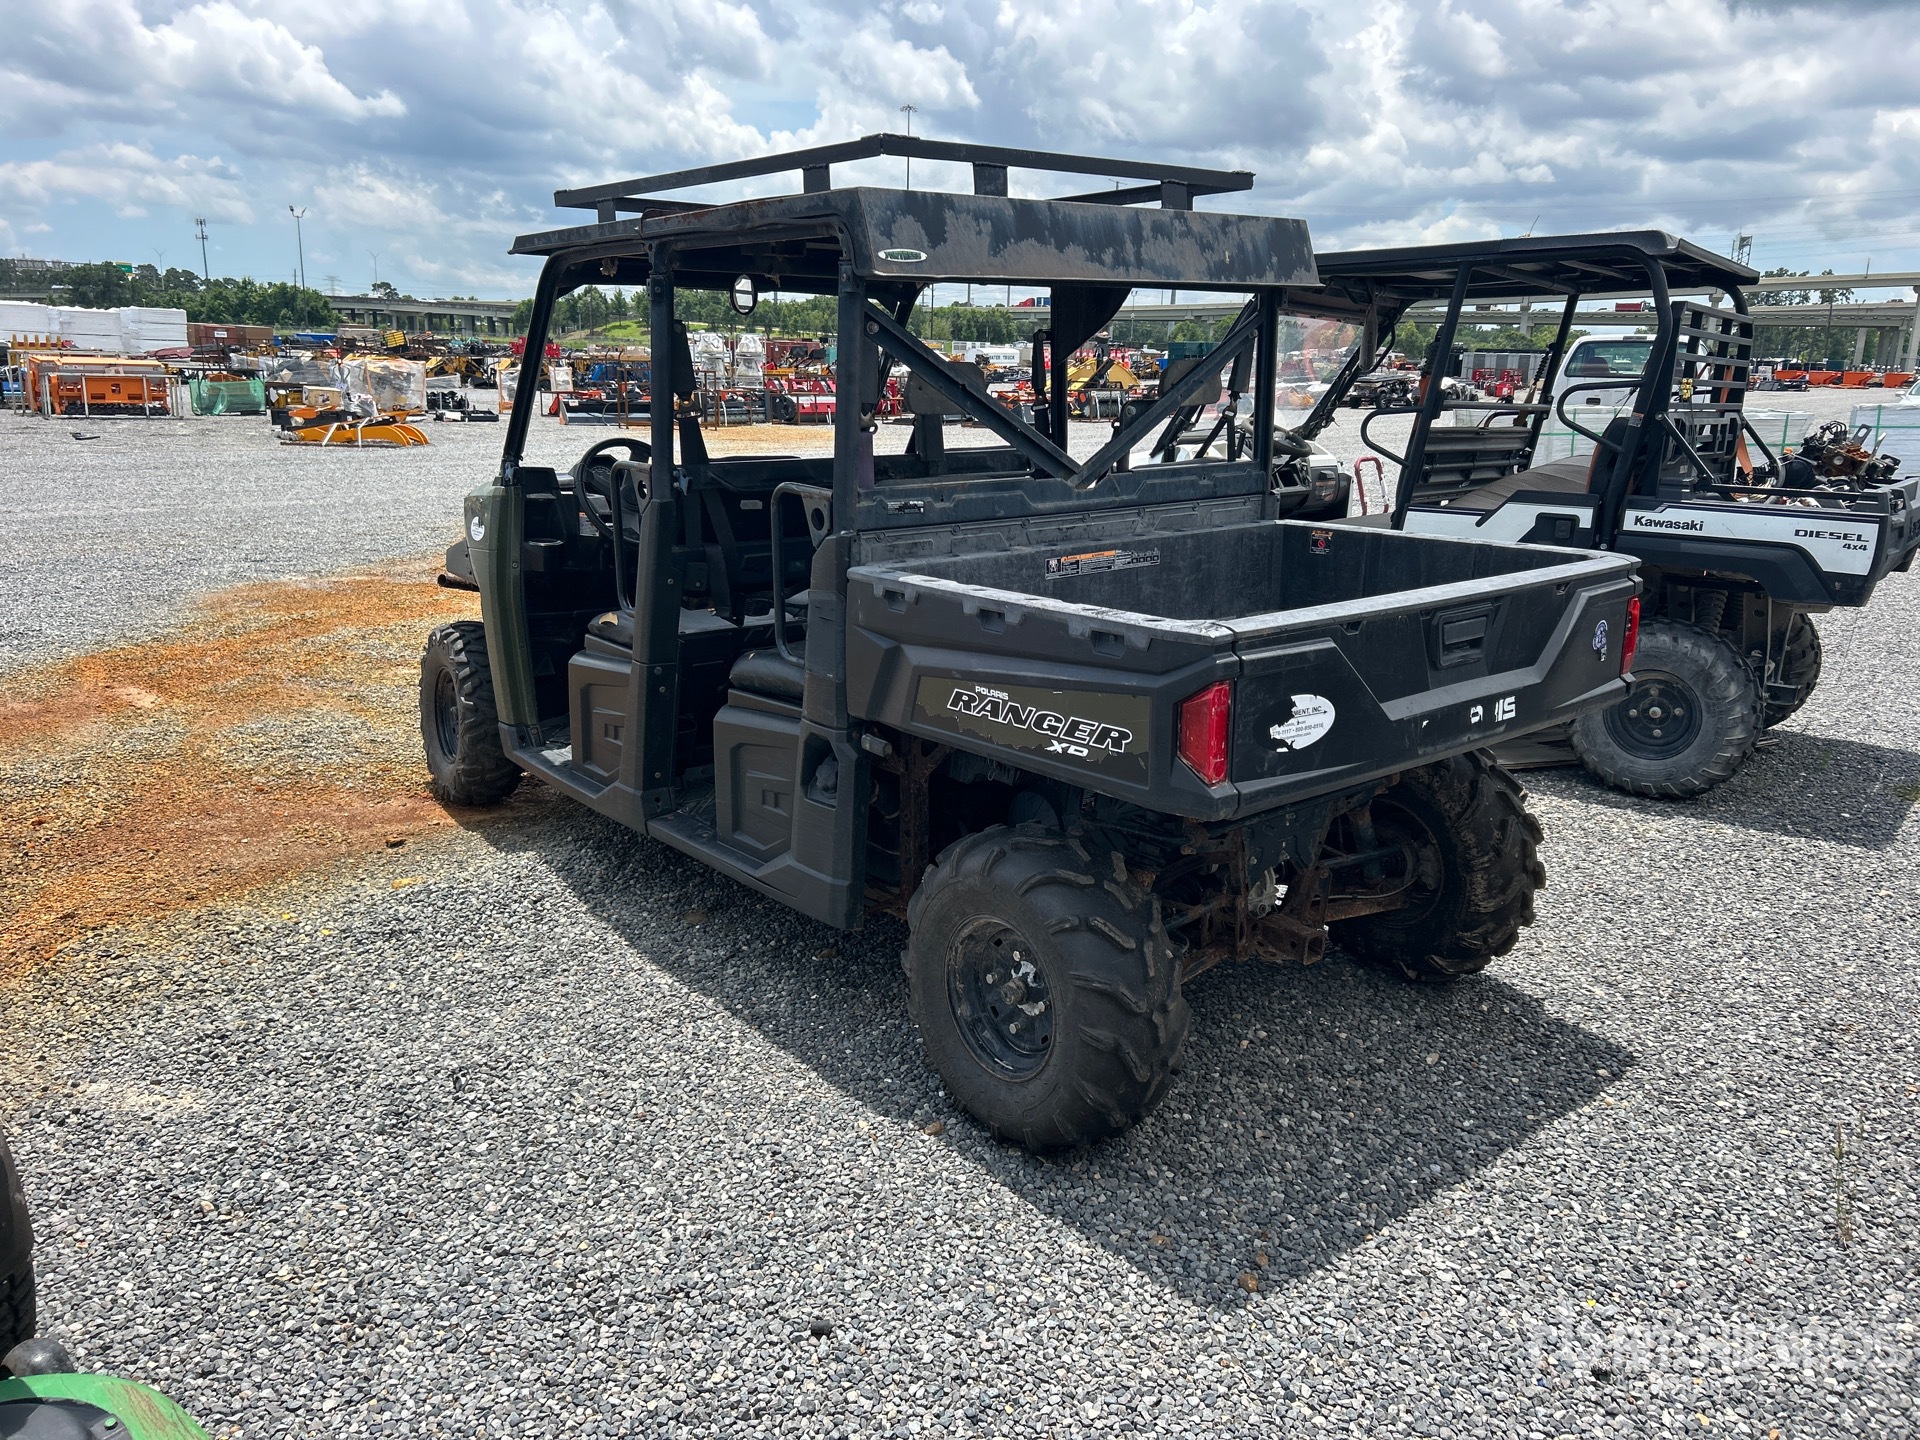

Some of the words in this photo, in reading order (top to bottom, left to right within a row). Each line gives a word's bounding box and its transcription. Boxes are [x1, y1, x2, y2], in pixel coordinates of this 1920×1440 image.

[1633, 515, 1704, 532] Kawasaki
[1794, 528, 1870, 543] DIESEL
[1842, 542, 1869, 552] 4x4
[975, 685, 1009, 701] POLARIS
[947, 688, 1133, 754] RANGER
[1045, 739, 1089, 758] XD
